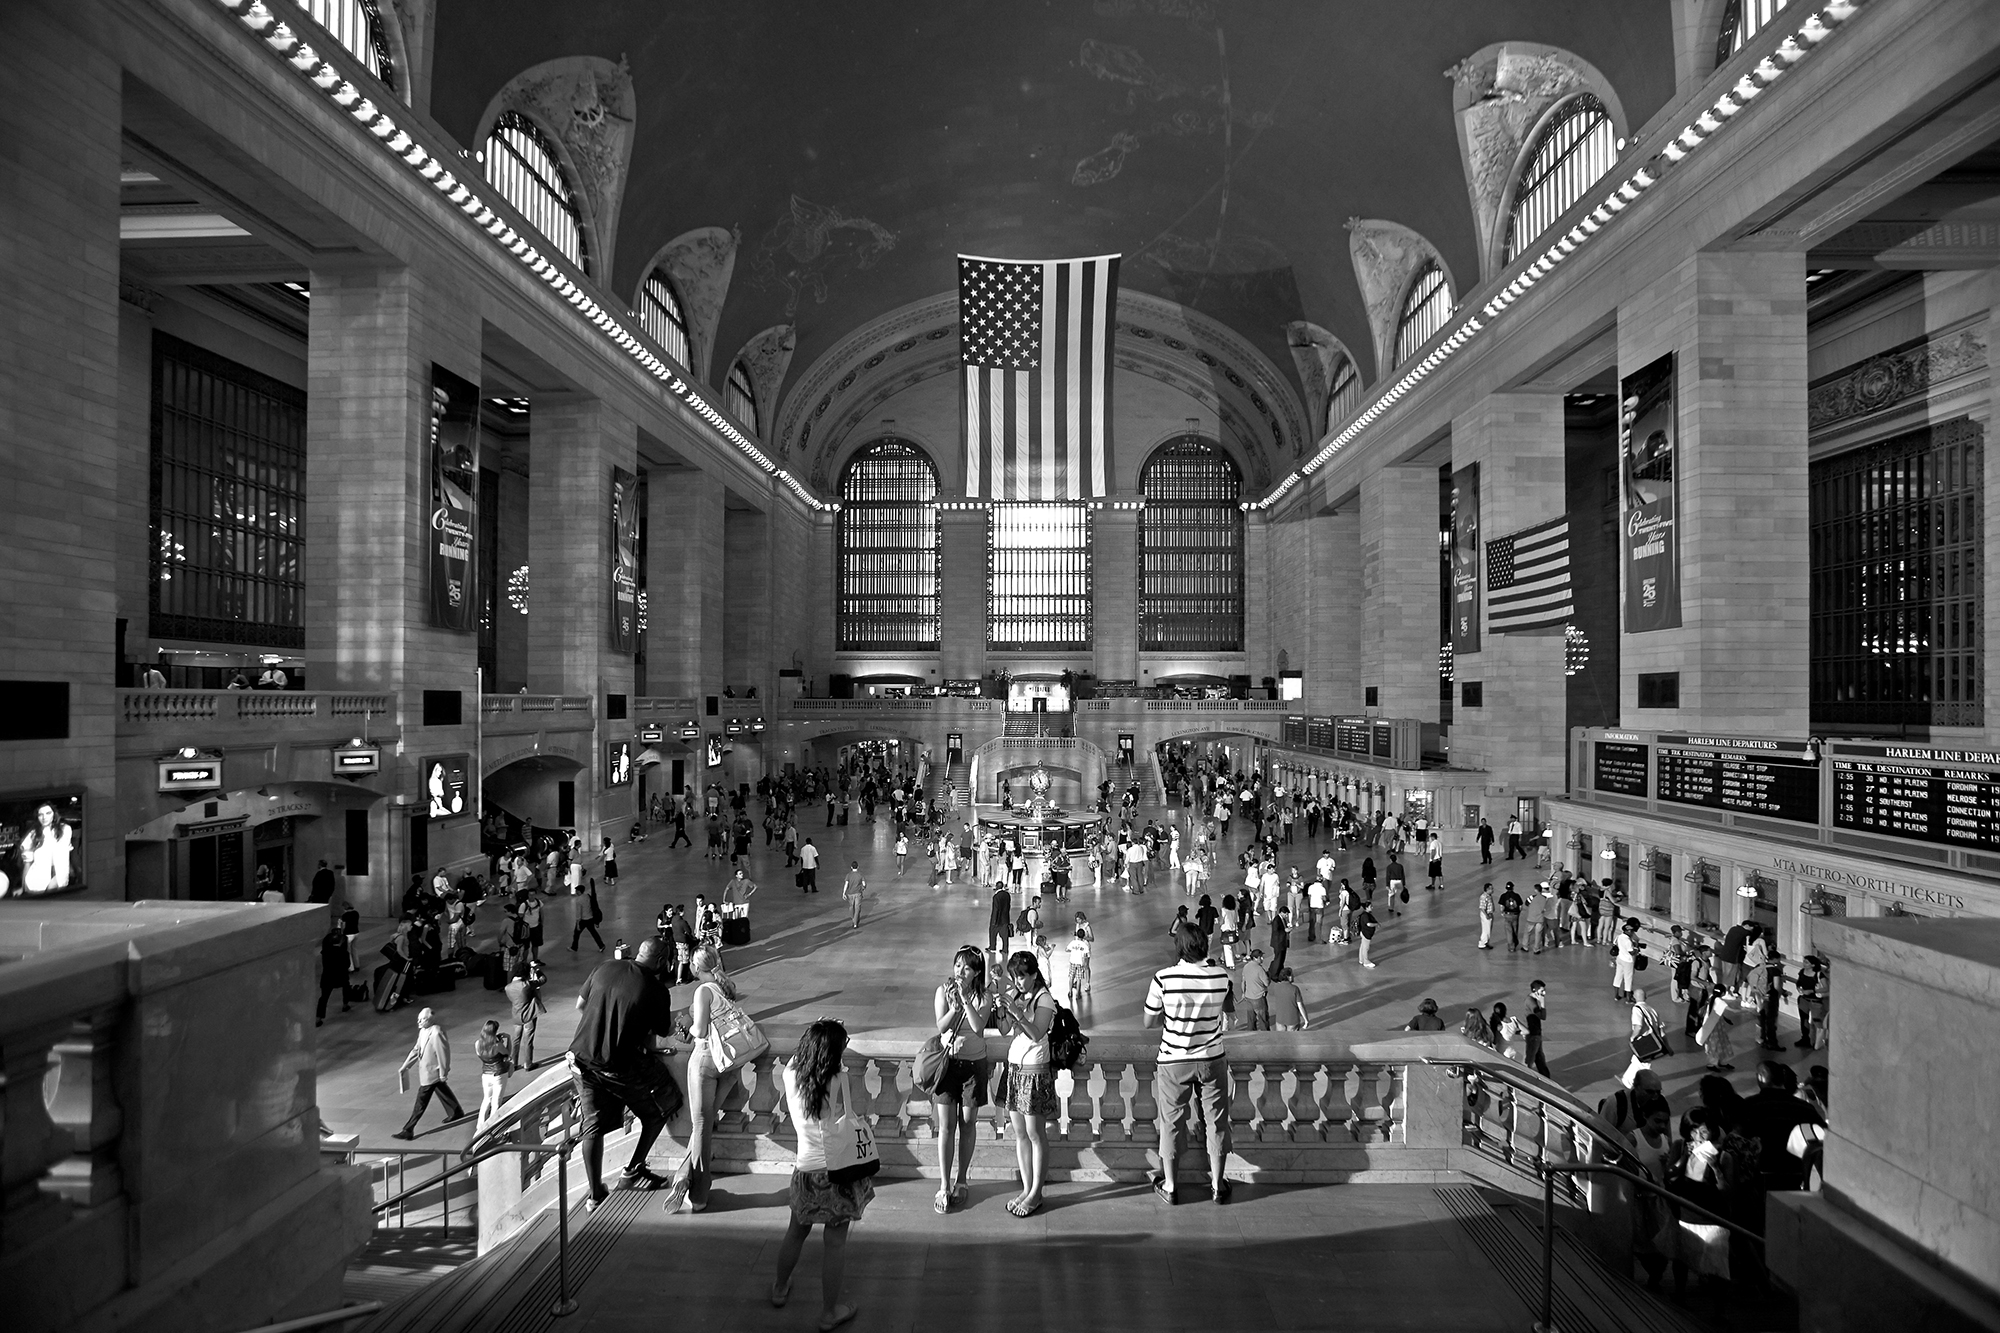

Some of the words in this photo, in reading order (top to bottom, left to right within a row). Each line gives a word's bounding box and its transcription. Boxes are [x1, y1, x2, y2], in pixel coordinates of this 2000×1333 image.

[1628, 510, 1661, 538] Celebrating
[440, 542, 469, 562] RUNNING
[1633, 540, 1665, 560] RUNNING
[1643, 584, 1656, 599] 25
[1605, 732, 1639, 741] INFORMATION
[1688, 737, 1715, 746] HARLEM
[1715, 738, 1731, 747] LINE
[1732, 739, 1778, 750] DEPARTURES
[1682, 750, 1715, 759] DESTINATION
[1721, 753, 1747, 761] REMARKS
[1886, 747, 1931, 760] HARLEM
[1934, 750, 1962, 762] LINE
[1834, 761, 1853, 770] TIME
[1856, 763, 1873, 772] TRK
[1877, 765, 1932, 777] DESTINATION
[1944, 769, 1990, 781] REMARKS
[1837, 772, 1854, 781] 12:55
[1865, 774, 1874, 782] 30
[1879, 776, 1890, 784] NO.
[1904, 778, 1928, 788] PLAINS
[1946, 782, 1978, 792] FORDHAM
[1840, 783, 1854, 791] 1:25
[1879, 787, 1890, 795] NO.
[1904, 789, 1928, 799] PLAINS
[1946, 794, 1978, 805] MELROSE
[277, 803, 304, 813] TRACKS
[1840, 803, 1854, 812] 1:55
[1879, 808, 1890, 817] NO.
[1904, 811, 1928, 822] PLAINS
[1946, 816, 1978, 828] FORDHAM
[1879, 798, 1913, 808] SOUTHEAST
[1946, 805, 1992, 819] CONNECTION
[1879, 819, 1890, 828] NO.
[1904, 822, 1928, 833] PLAINS
[1946, 828, 1978, 840] FORDHAM
[1773, 857, 1797, 872] MTA
[1800, 863, 1895, 894] METRO-NORTH
[1900, 884, 1965, 909] TICKETS
[855, 1128, 863, 1144] I
